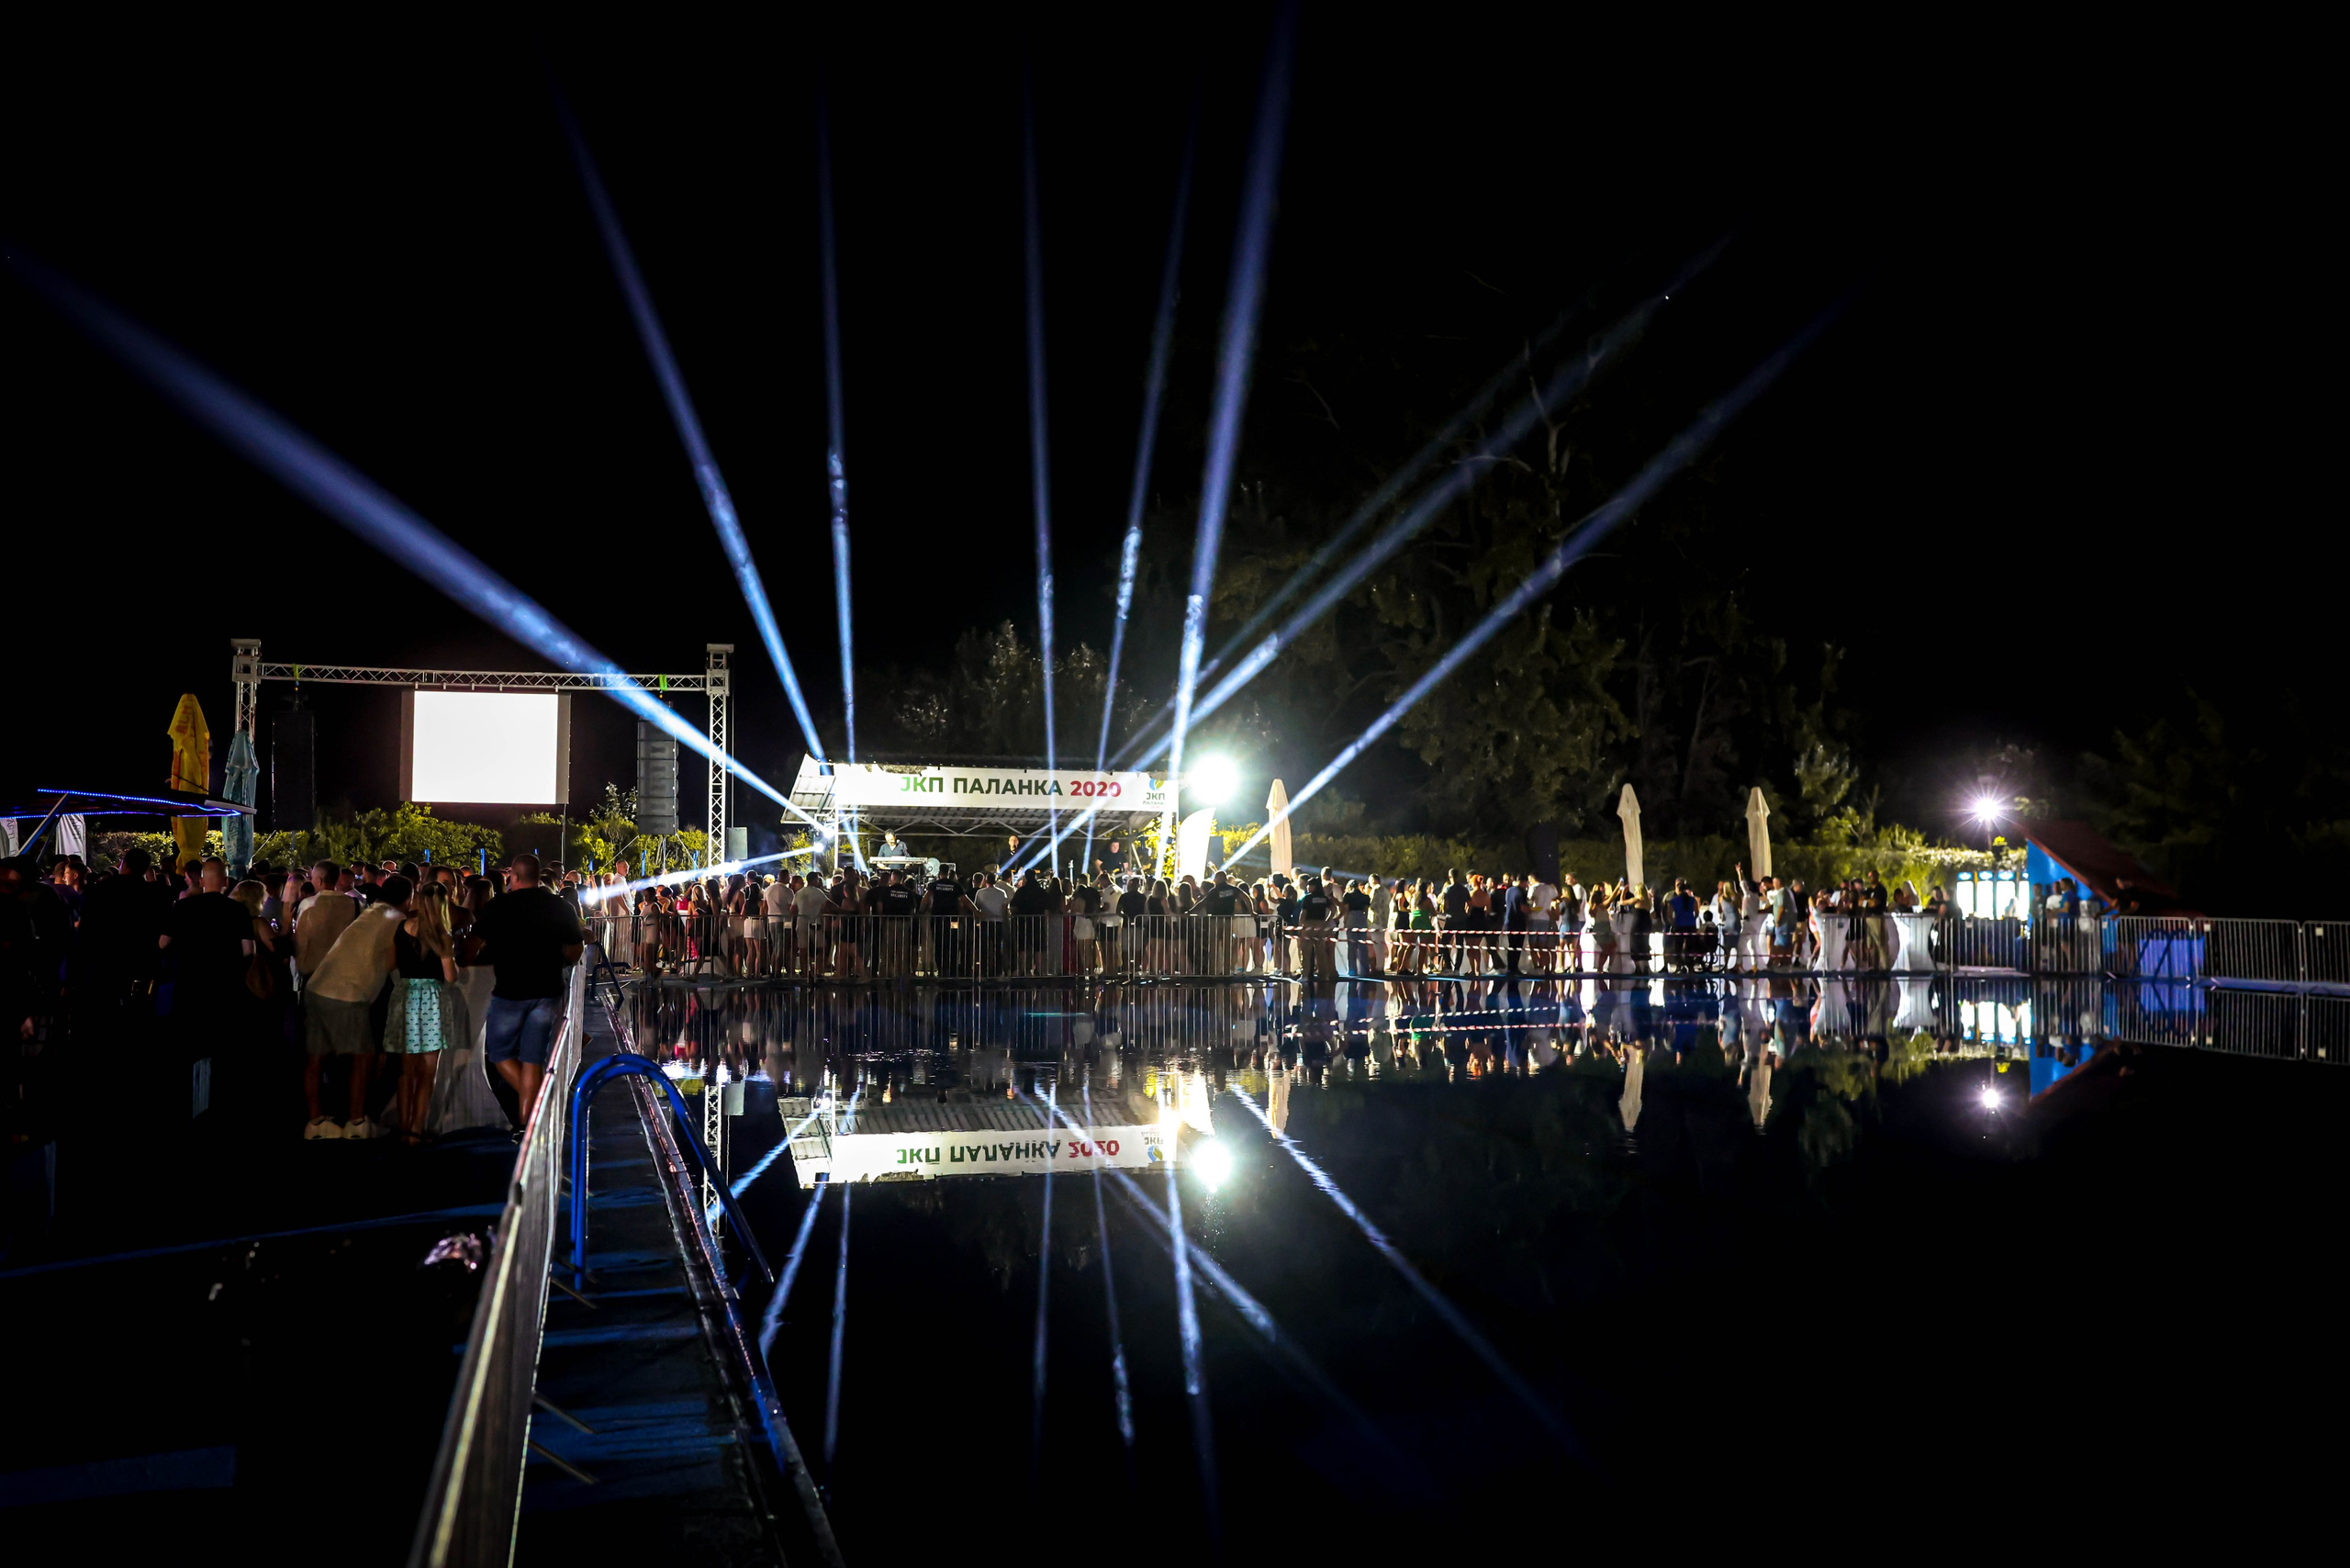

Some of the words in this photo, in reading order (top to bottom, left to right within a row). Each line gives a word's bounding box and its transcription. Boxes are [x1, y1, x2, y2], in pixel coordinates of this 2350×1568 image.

[901, 777, 944, 792] ЈКП
[953, 778, 1063, 796] ПАЛАНКА
[1069, 780, 1122, 798] 2020
[1146, 792, 1166, 801] ЈКП
